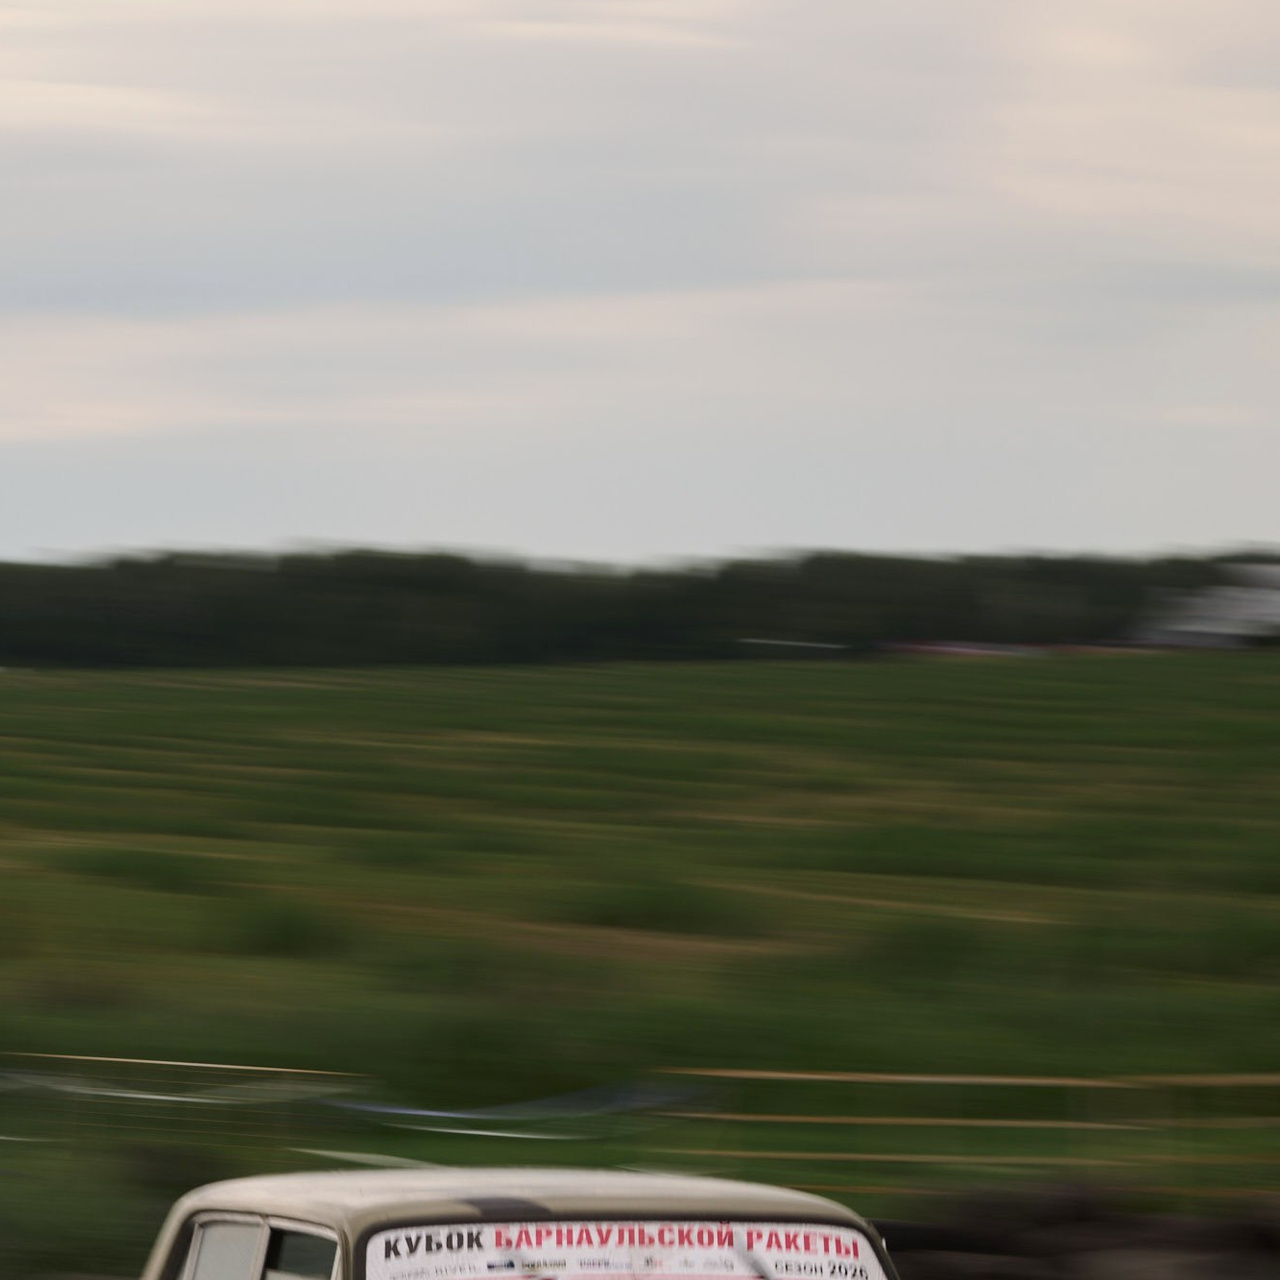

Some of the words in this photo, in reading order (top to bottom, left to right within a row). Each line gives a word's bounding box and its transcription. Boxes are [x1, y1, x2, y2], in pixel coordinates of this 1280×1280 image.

[384, 1229, 483, 1261] КУБОК
[494, 1221, 735, 1251] БАРНАУЛЬСКОЙ
[746, 1228, 860, 1259] РАКЕТЫ
[774, 1260, 824, 1277] СЕЗОН
